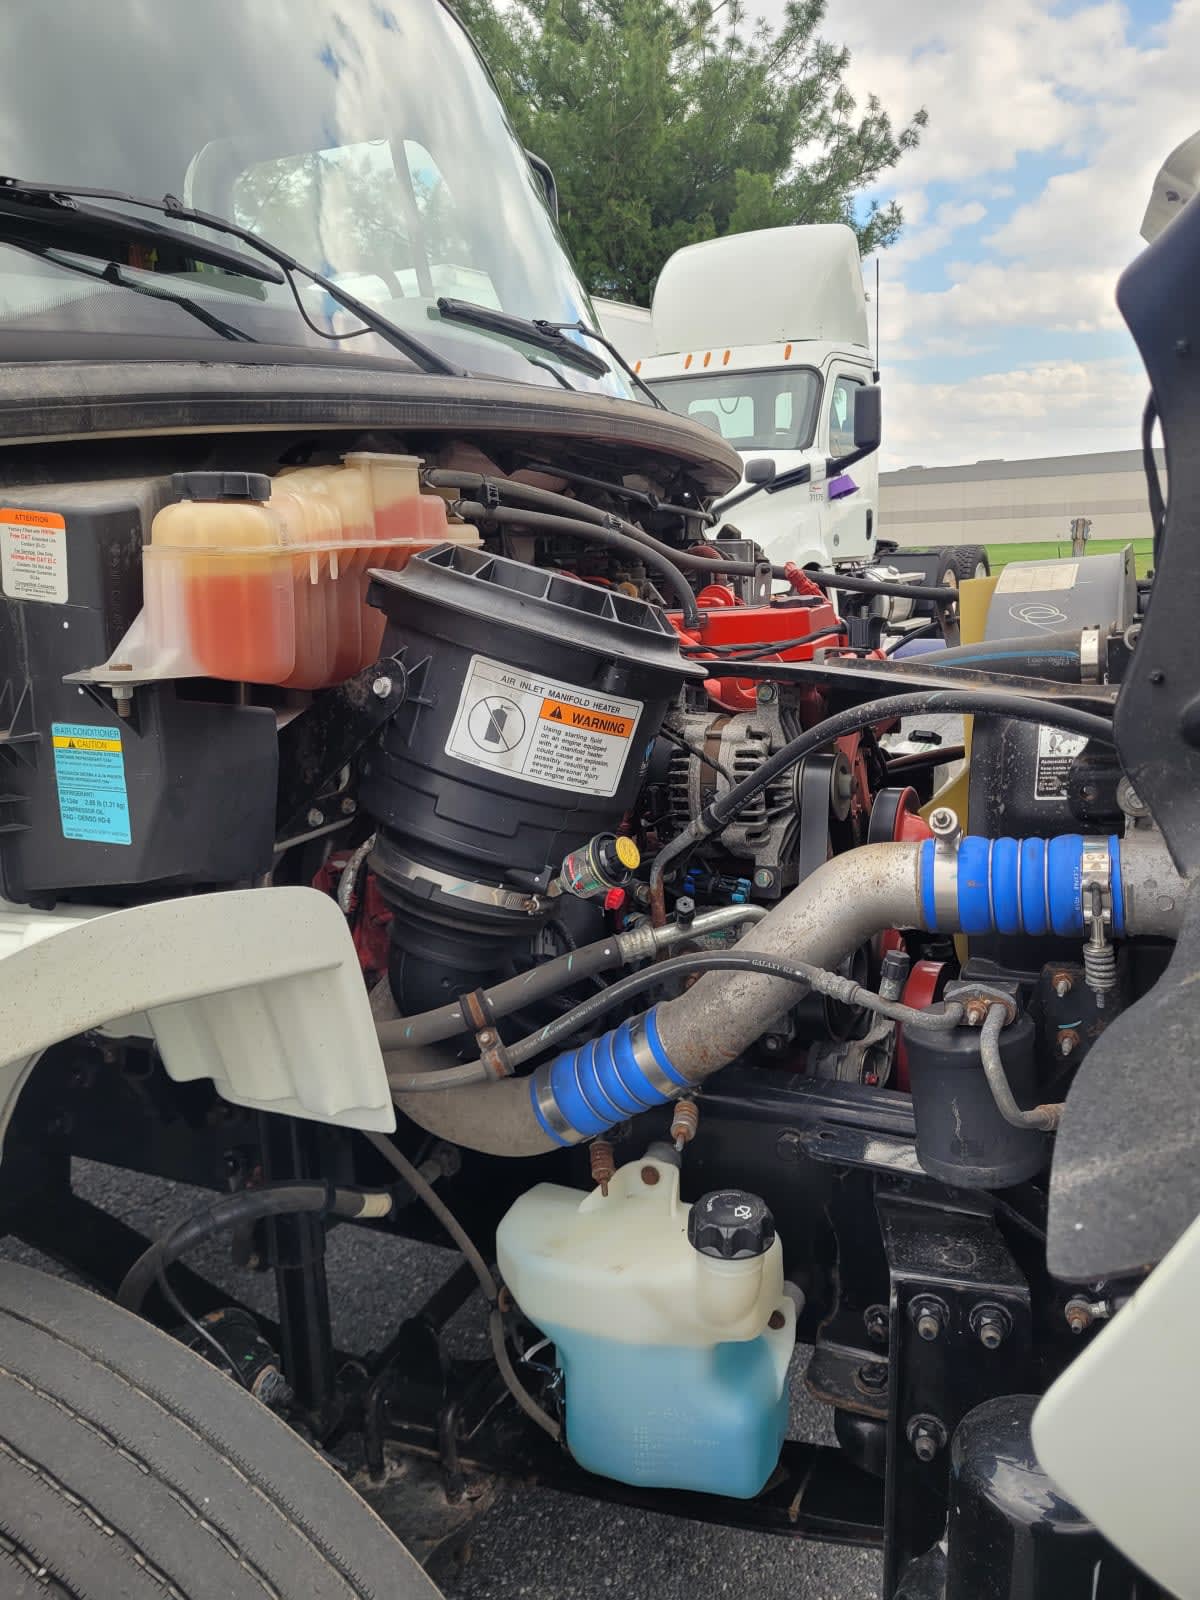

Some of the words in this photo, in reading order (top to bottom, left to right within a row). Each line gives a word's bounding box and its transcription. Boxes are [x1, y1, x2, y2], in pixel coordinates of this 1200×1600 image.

[15, 514, 48, 523] ATTENTION
[501, 675, 516, 686] AIR
[520, 682, 545, 694] INLET
[548, 690, 590, 707] MANIFOLD
[592, 702, 620, 713] HEATER
[572, 712, 625, 734] WARNING
[60, 727, 72, 735] AIR
[73, 727, 119, 738] CONDITIONER
[543, 725, 562, 736] Using
[565, 732, 588, 742] starting
[77, 739, 107, 749] CAUTION
[562, 738, 581, 746] engine
[537, 747, 554, 755] could
[560, 746, 586, 755] manifold
[534, 754, 560, 765] possibly
[564, 761, 589, 771] resulting
[532, 761, 553, 770] severe
[556, 767, 582, 776] personal
[584, 772, 599, 780] injury
[544, 771, 564, 779] engine
[752, 959, 780, 970] GALAXY
